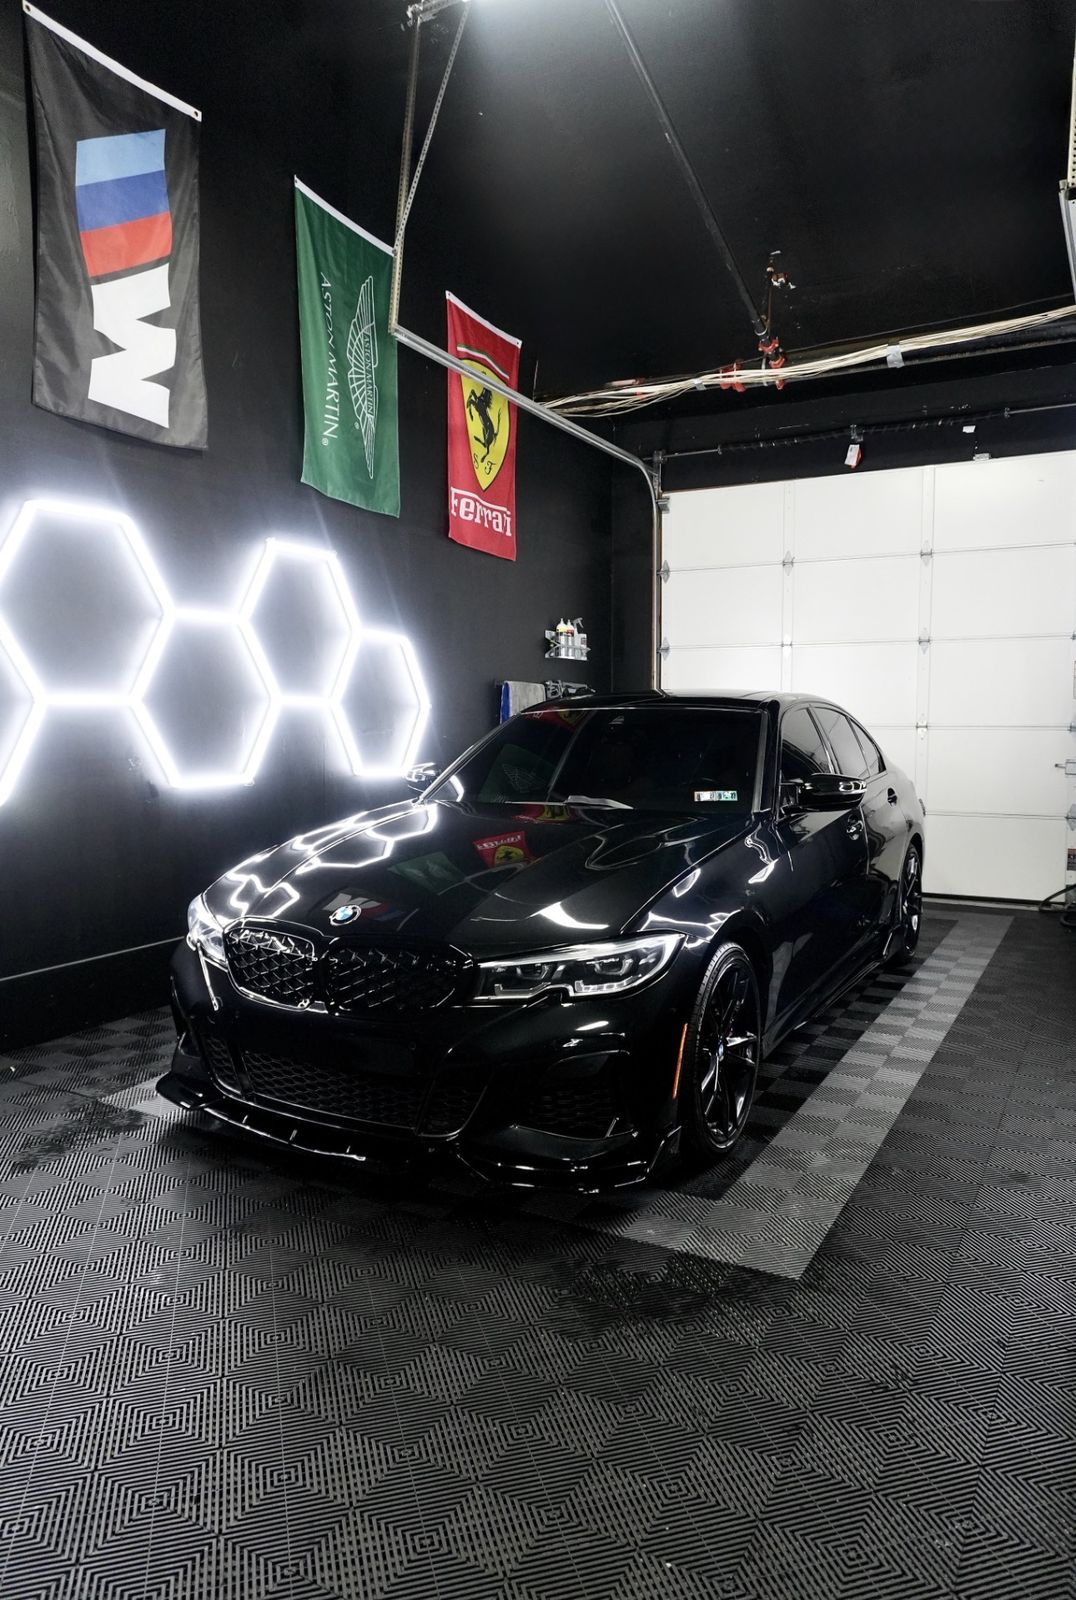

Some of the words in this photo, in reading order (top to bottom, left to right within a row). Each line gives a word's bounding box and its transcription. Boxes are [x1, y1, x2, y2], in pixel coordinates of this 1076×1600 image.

[320, 271, 336, 349] ASTON
[87, 262, 177, 428] M
[363, 333, 372, 370] ASTON
[365, 372, 375, 415] MARTIN
